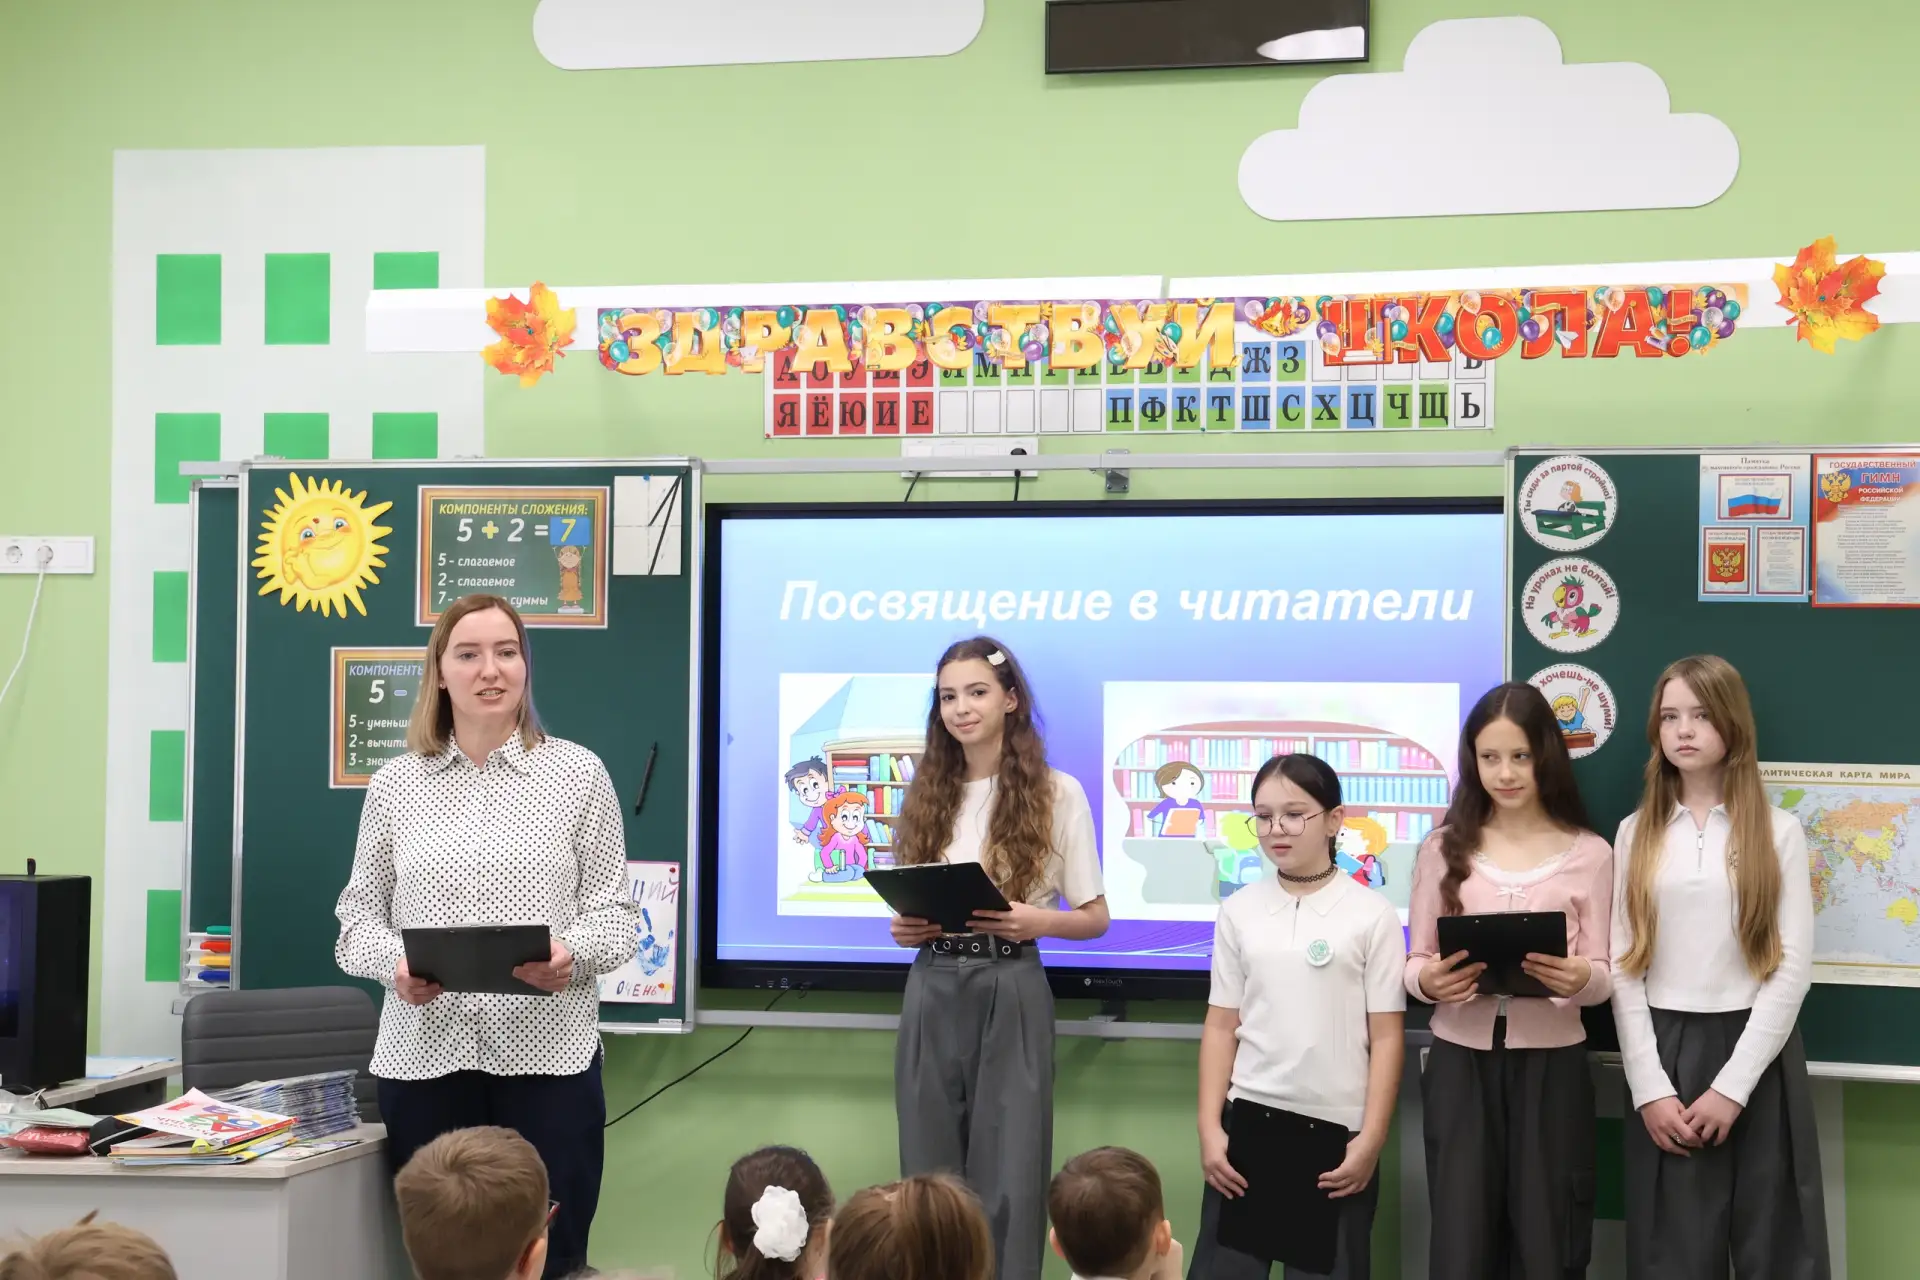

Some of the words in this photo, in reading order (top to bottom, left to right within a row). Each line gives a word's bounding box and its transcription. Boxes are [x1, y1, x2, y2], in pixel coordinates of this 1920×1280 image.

[1322, 289, 1693, 365] ШКОЛА!
[1242, 346, 1270, 374] Ж
[1283, 346, 1299, 373] З
[777, 401, 797, 427] Я
[812, 396, 829, 427] Ё
[839, 400, 866, 427] Ю
[876, 400, 897, 426] И
[912, 400, 929, 425] Е
[1109, 397, 1131, 423] П
[1141, 396, 1165, 422] Ф
[1176, 396, 1197, 422] К
[1212, 396, 1231, 421] Т
[1242, 395, 1270, 421] Ш
[1282, 394, 1299, 421] С
[1315, 394, 1338, 420] Х
[1350, 393, 1374, 426] Ц
[1387, 393, 1409, 419] Ч
[1419, 392, 1448, 425] Щ
[1461, 392, 1480, 418] Ь
[1829, 461, 1916, 469] ГОСУДАРСТВЕННЫЙ
[1861, 472, 1900, 484] ГИМН
[1523, 500, 1531, 513] Ты
[1527, 478, 1541, 498] сиди
[1540, 470, 1550, 480] за
[1551, 463, 1583, 473] партой
[1583, 467, 1612, 501] стройно!
[439, 504, 518, 515] КОМПОНЕНТЫ
[521, 504, 588, 515] СЛОЖЕНИЯ:
[456, 518, 473, 542] 5
[481, 520, 499, 540] +
[507, 518, 525, 542] 2
[534, 524, 549, 536] =
[560, 518, 577, 543] 7
[438, 553, 447, 566] 5
[457, 557, 516, 567] слагаемое
[438, 573, 447, 586] 2
[457, 577, 516, 587] слагаемое
[1530, 566, 1562, 594] уроках
[1581, 565, 1615, 599] болтай!
[438, 591, 447, 605] 7
[510, 597, 549, 607] суммы
[779, 580, 1112, 629] Посвящение
[1129, 589, 1158, 621] в
[1179, 589, 1474, 621] читатели
[1525, 595, 1536, 610] На
[369, 679, 385, 703] 5
[1597, 692, 1614, 732] шуми!
[349, 714, 357, 728] 5
[349, 734, 358, 748] 2
[367, 739, 408, 748] вычита
[349, 753, 357, 766] 3
[366, 757, 392, 766] знач
[1840, 771, 1873, 779] КАРТА
